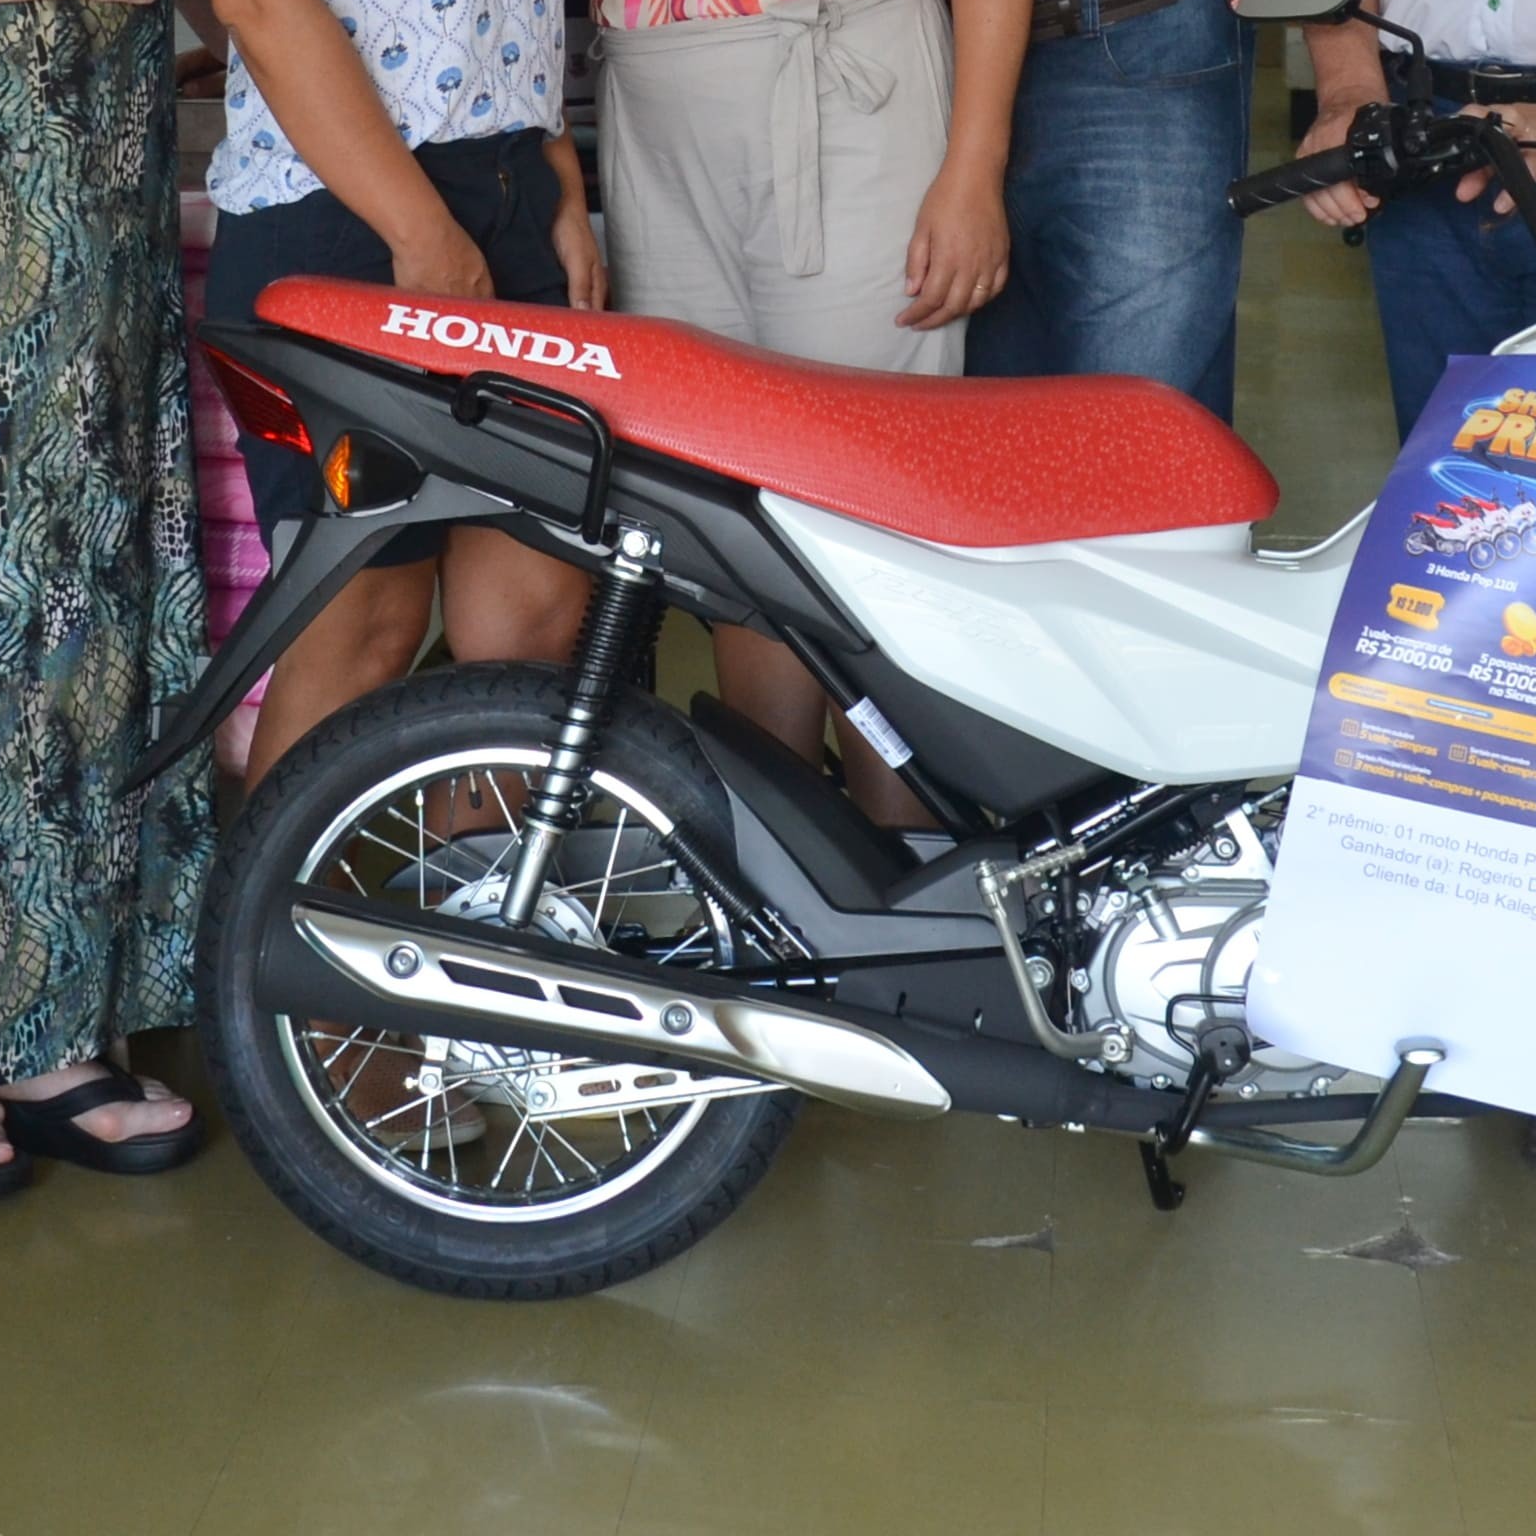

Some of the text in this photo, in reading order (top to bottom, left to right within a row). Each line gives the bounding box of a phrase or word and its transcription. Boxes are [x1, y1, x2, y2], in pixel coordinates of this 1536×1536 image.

[380, 303, 622, 380] HONDA
[1436, 564, 1470, 582] Honda
[1470, 572, 1493, 589] Pop
[1493, 578, 1519, 592] 110i
[1368, 629, 1437, 654] vale-compras
[1438, 643, 1453, 656] de
[1378, 643, 1453, 672] 2.000,00
[1480, 653, 1489, 664] 5
[1328, 808, 1390, 837] prêmio:
[1394, 825, 1414, 841] 01
[1419, 832, 1461, 852] moto
[1465, 840, 1519, 865] Honda
[1340, 834, 1423, 864] Ganhador
[1426, 855, 1453, 875] (a):
[1458, 861, 1523, 889] Rogerio
[1362, 863, 1420, 889] Cliente
[1424, 876, 1449, 895] da:
[1455, 883, 1490, 905] Loja
